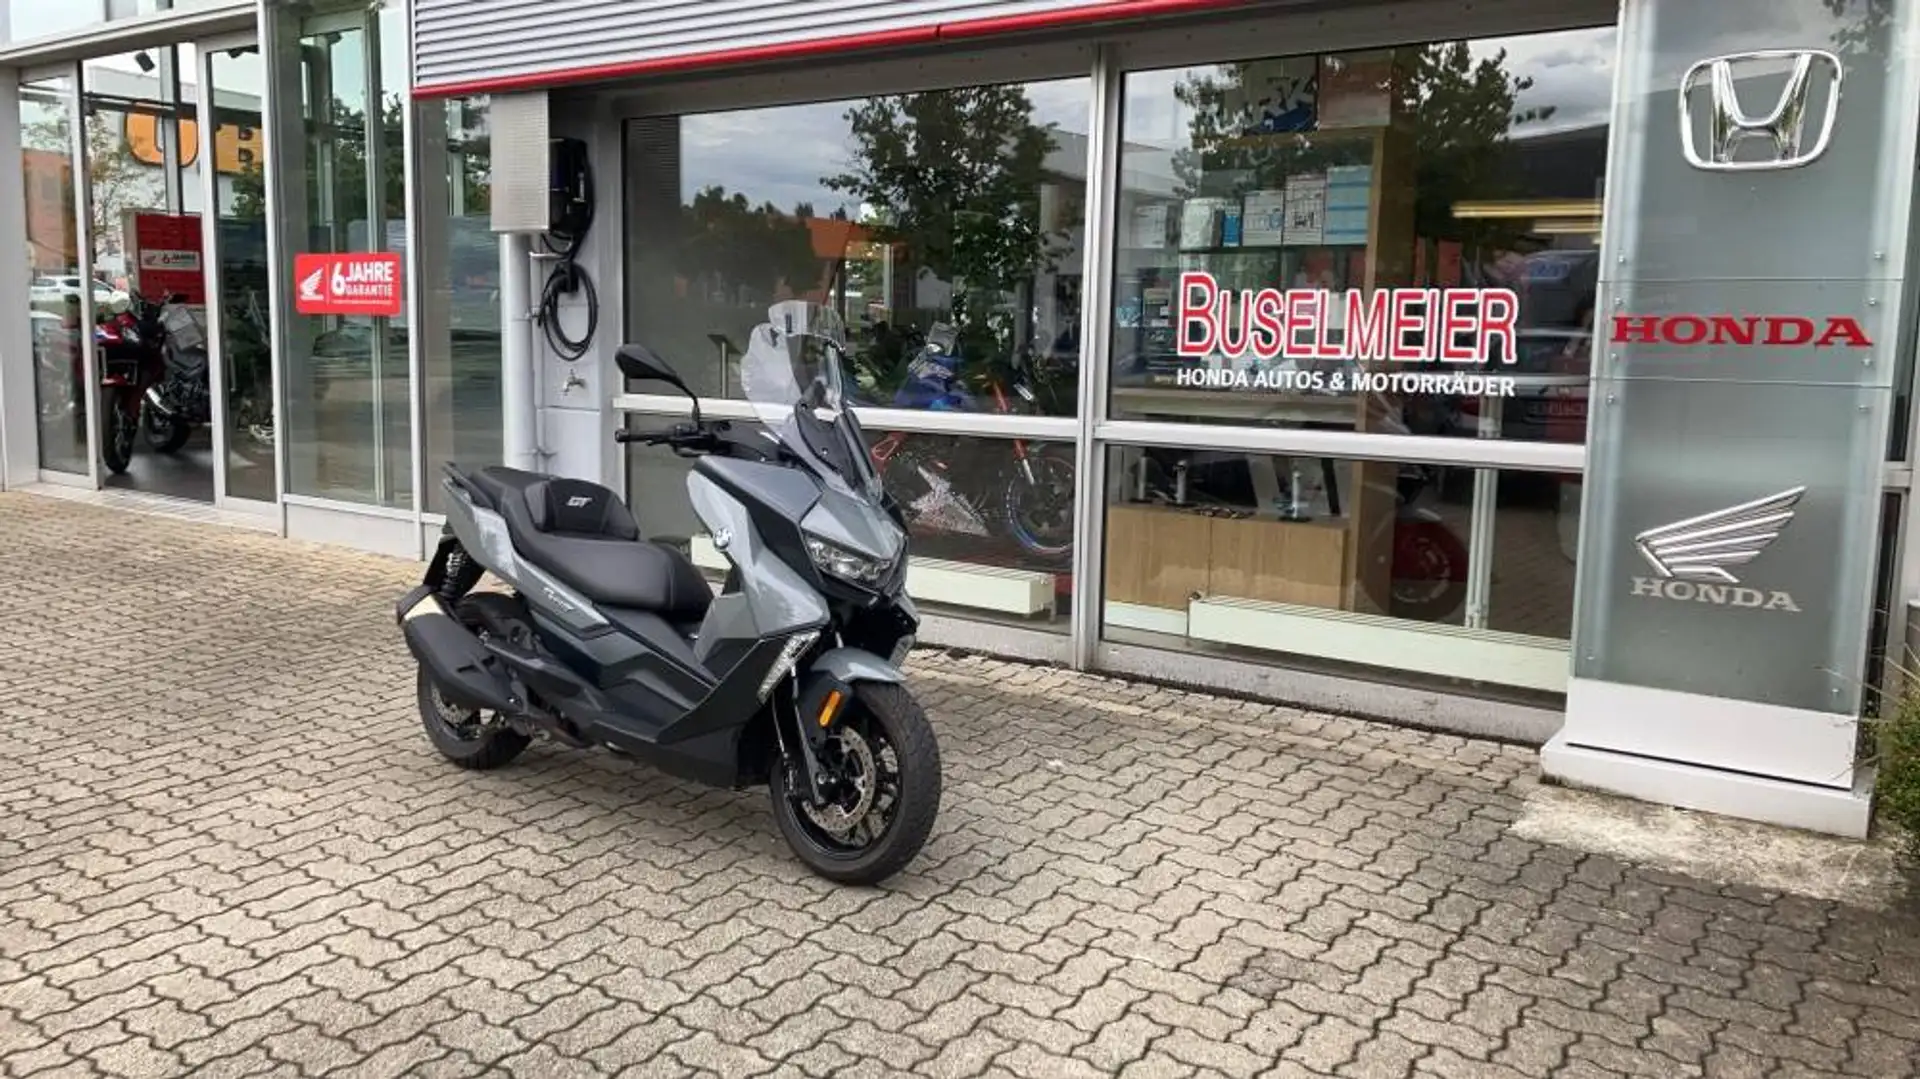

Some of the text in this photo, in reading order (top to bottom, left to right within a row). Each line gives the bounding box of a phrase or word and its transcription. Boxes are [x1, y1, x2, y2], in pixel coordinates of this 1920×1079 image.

[331, 261, 394, 296] 6 JAHRE
[345, 283, 393, 296] GARANTIE
[1177, 271, 1519, 364] BUSELMEIER
[1610, 315, 1874, 348] HONDA
[1177, 367, 1515, 396] HONDA AUTOS & MOTORRÄDER
[566, 496, 593, 508] GT
[1629, 575, 1802, 613] HONDA
